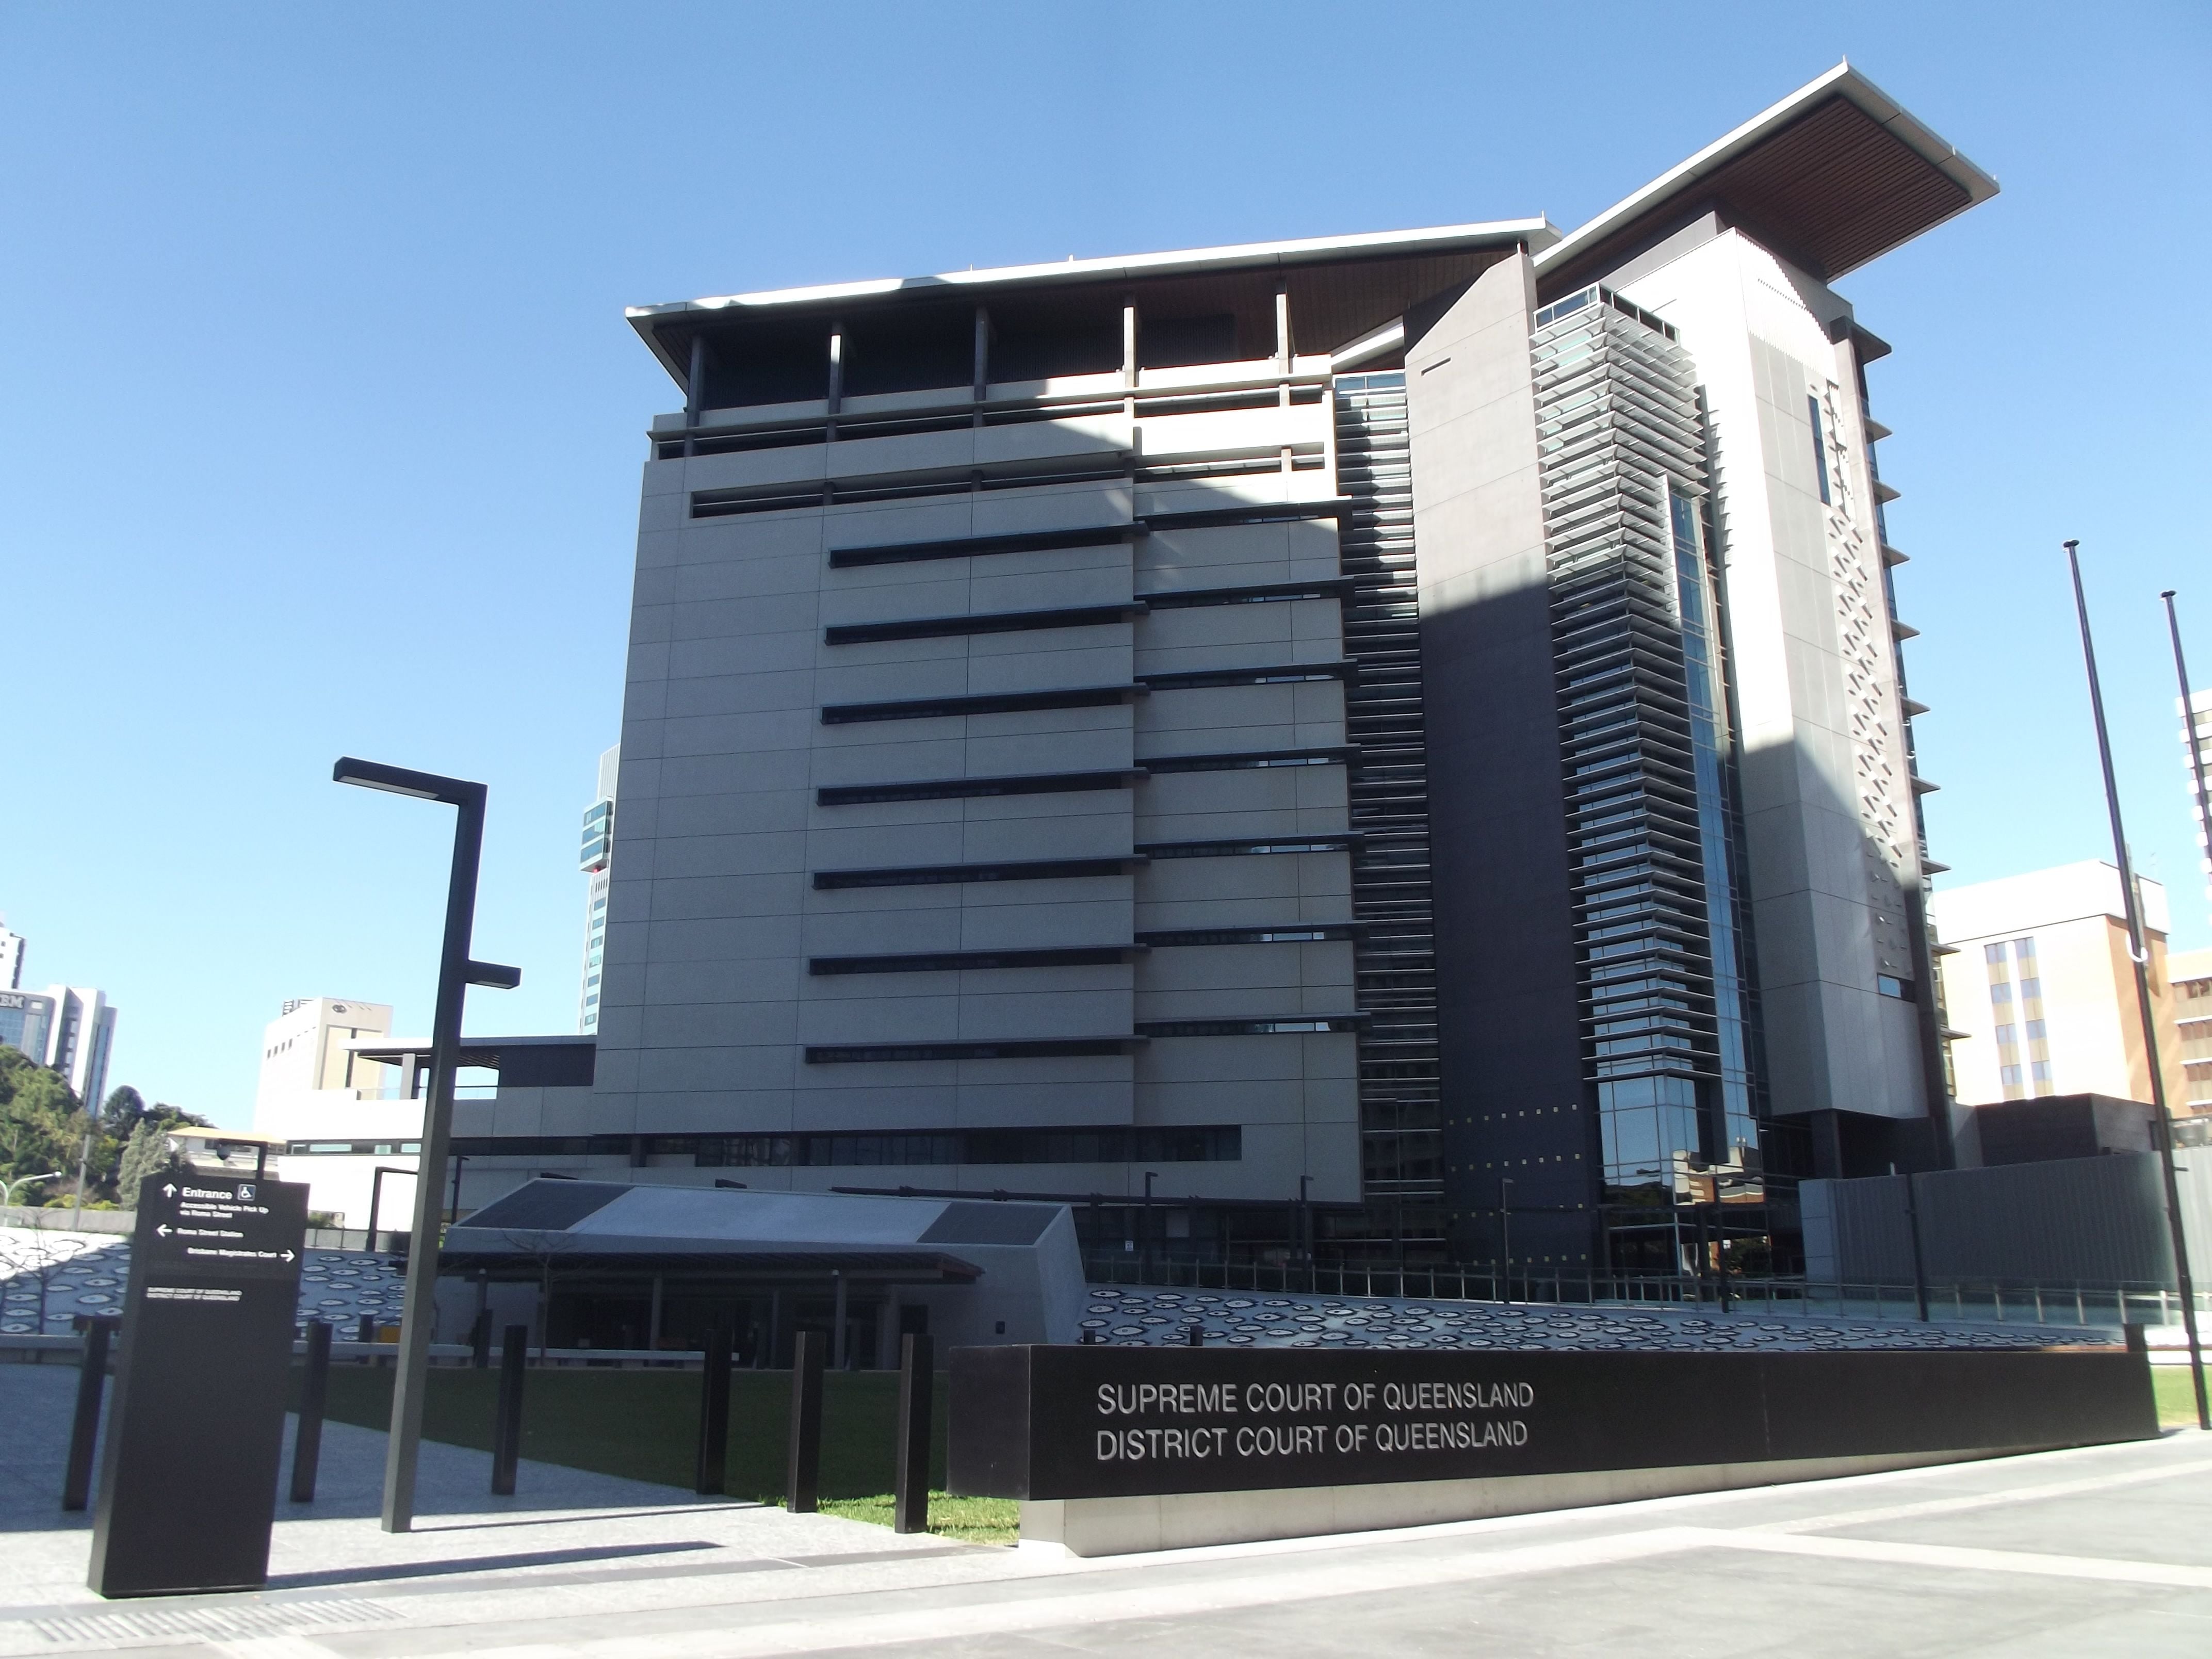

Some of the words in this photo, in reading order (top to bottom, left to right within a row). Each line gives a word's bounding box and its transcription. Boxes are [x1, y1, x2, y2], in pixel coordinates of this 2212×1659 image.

[182, 1187, 233, 1199] Entrance
[1097, 1384, 1238, 1414] SUPREME
[1246, 1383, 1337, 1412] COURT
[1344, 1383, 1376, 1411] OF
[1383, 1382, 1534, 1411] QUEENSLAND
[1097, 1427, 1228, 1460] DISTRICT
[1236, 1425, 1328, 1456] COURT
[1336, 1424, 1369, 1453] OF
[1375, 1420, 1528, 1452] QUEENSLAND
